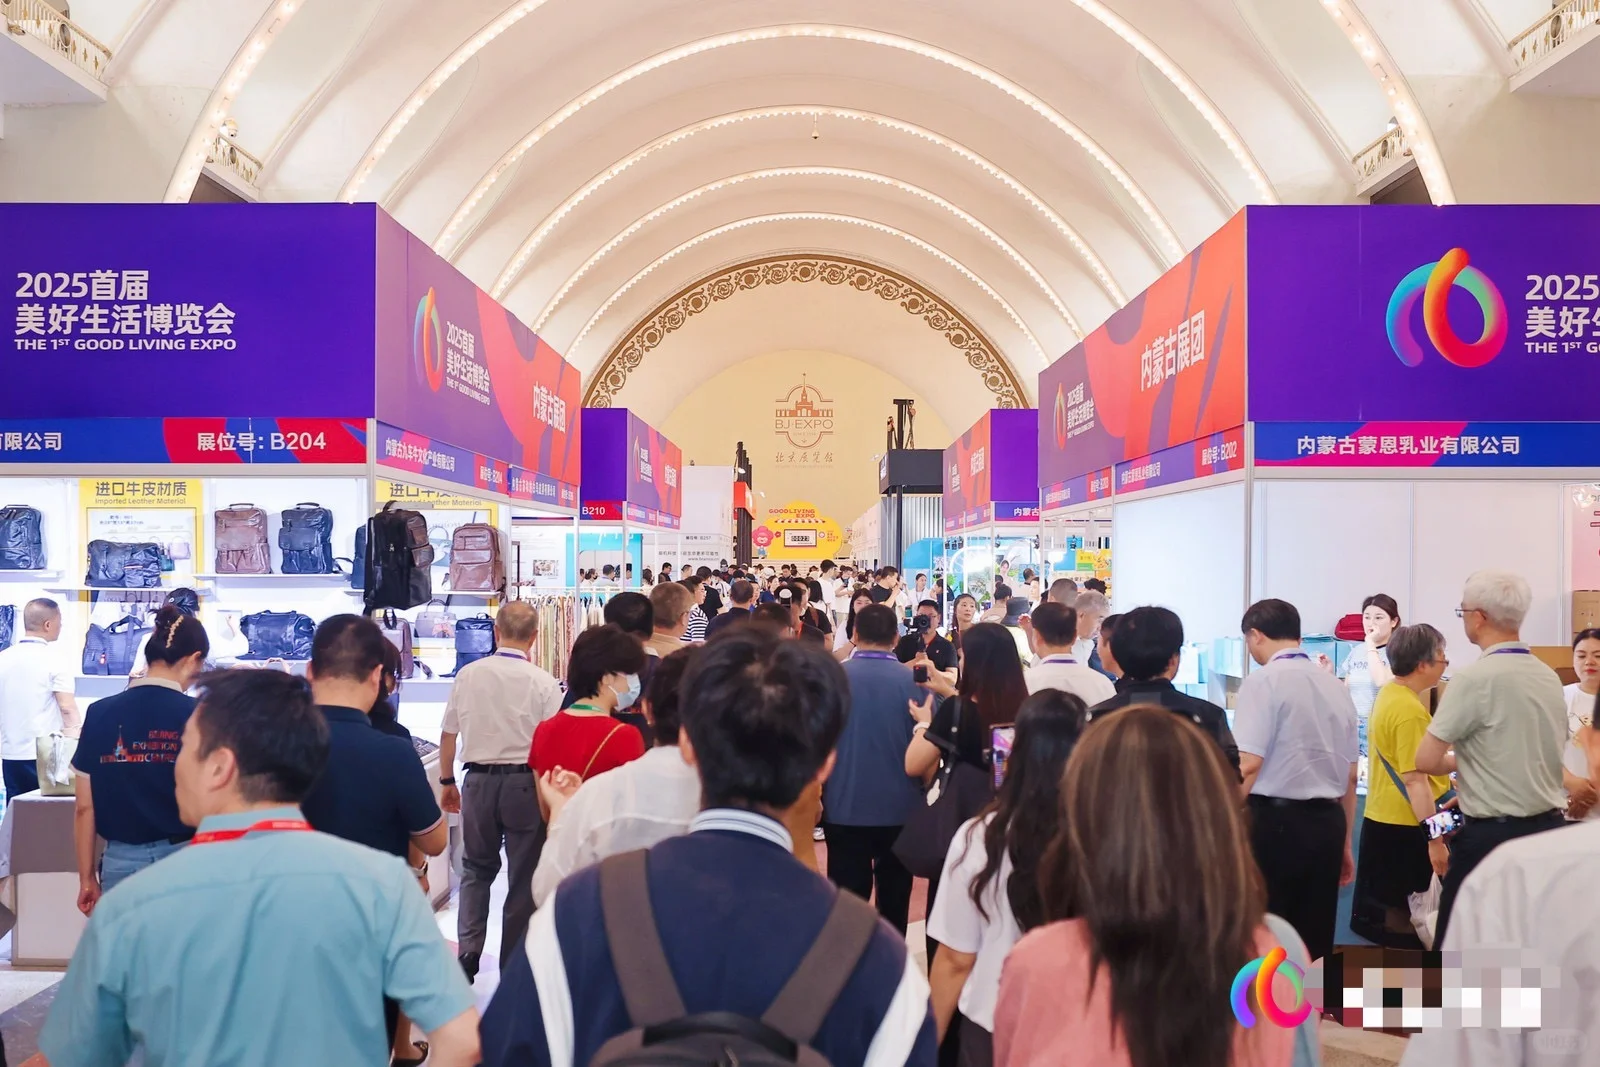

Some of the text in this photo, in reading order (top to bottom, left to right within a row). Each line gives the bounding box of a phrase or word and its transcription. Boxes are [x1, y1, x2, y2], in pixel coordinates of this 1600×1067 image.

[15, 270, 149, 300] 2025首届
[1525, 274, 1600, 300] 2025
[15, 303, 236, 335] 美好生活博览会
[14, 339, 47, 350] THE
[74, 339, 124, 350] GOOD
[129, 339, 185, 350] LIVING
[190, 339, 236, 350] EXPO
[446, 321, 475, 359] 2025首届
[1140, 310, 1205, 392] 内蒙古展团
[1524, 342, 1558, 353] THE
[1586, 342, 1600, 353] G
[446, 347, 490, 394] 美好生活博览会
[533, 380, 566, 434] 内蒙古展团
[0, 432, 62, 451] 限公司
[1297, 436, 1520, 455] 内蒙古蒙恩乳业有限公司
[96, 482, 187, 496] 进口牛皮材质
[582, 507, 606, 515] B210
